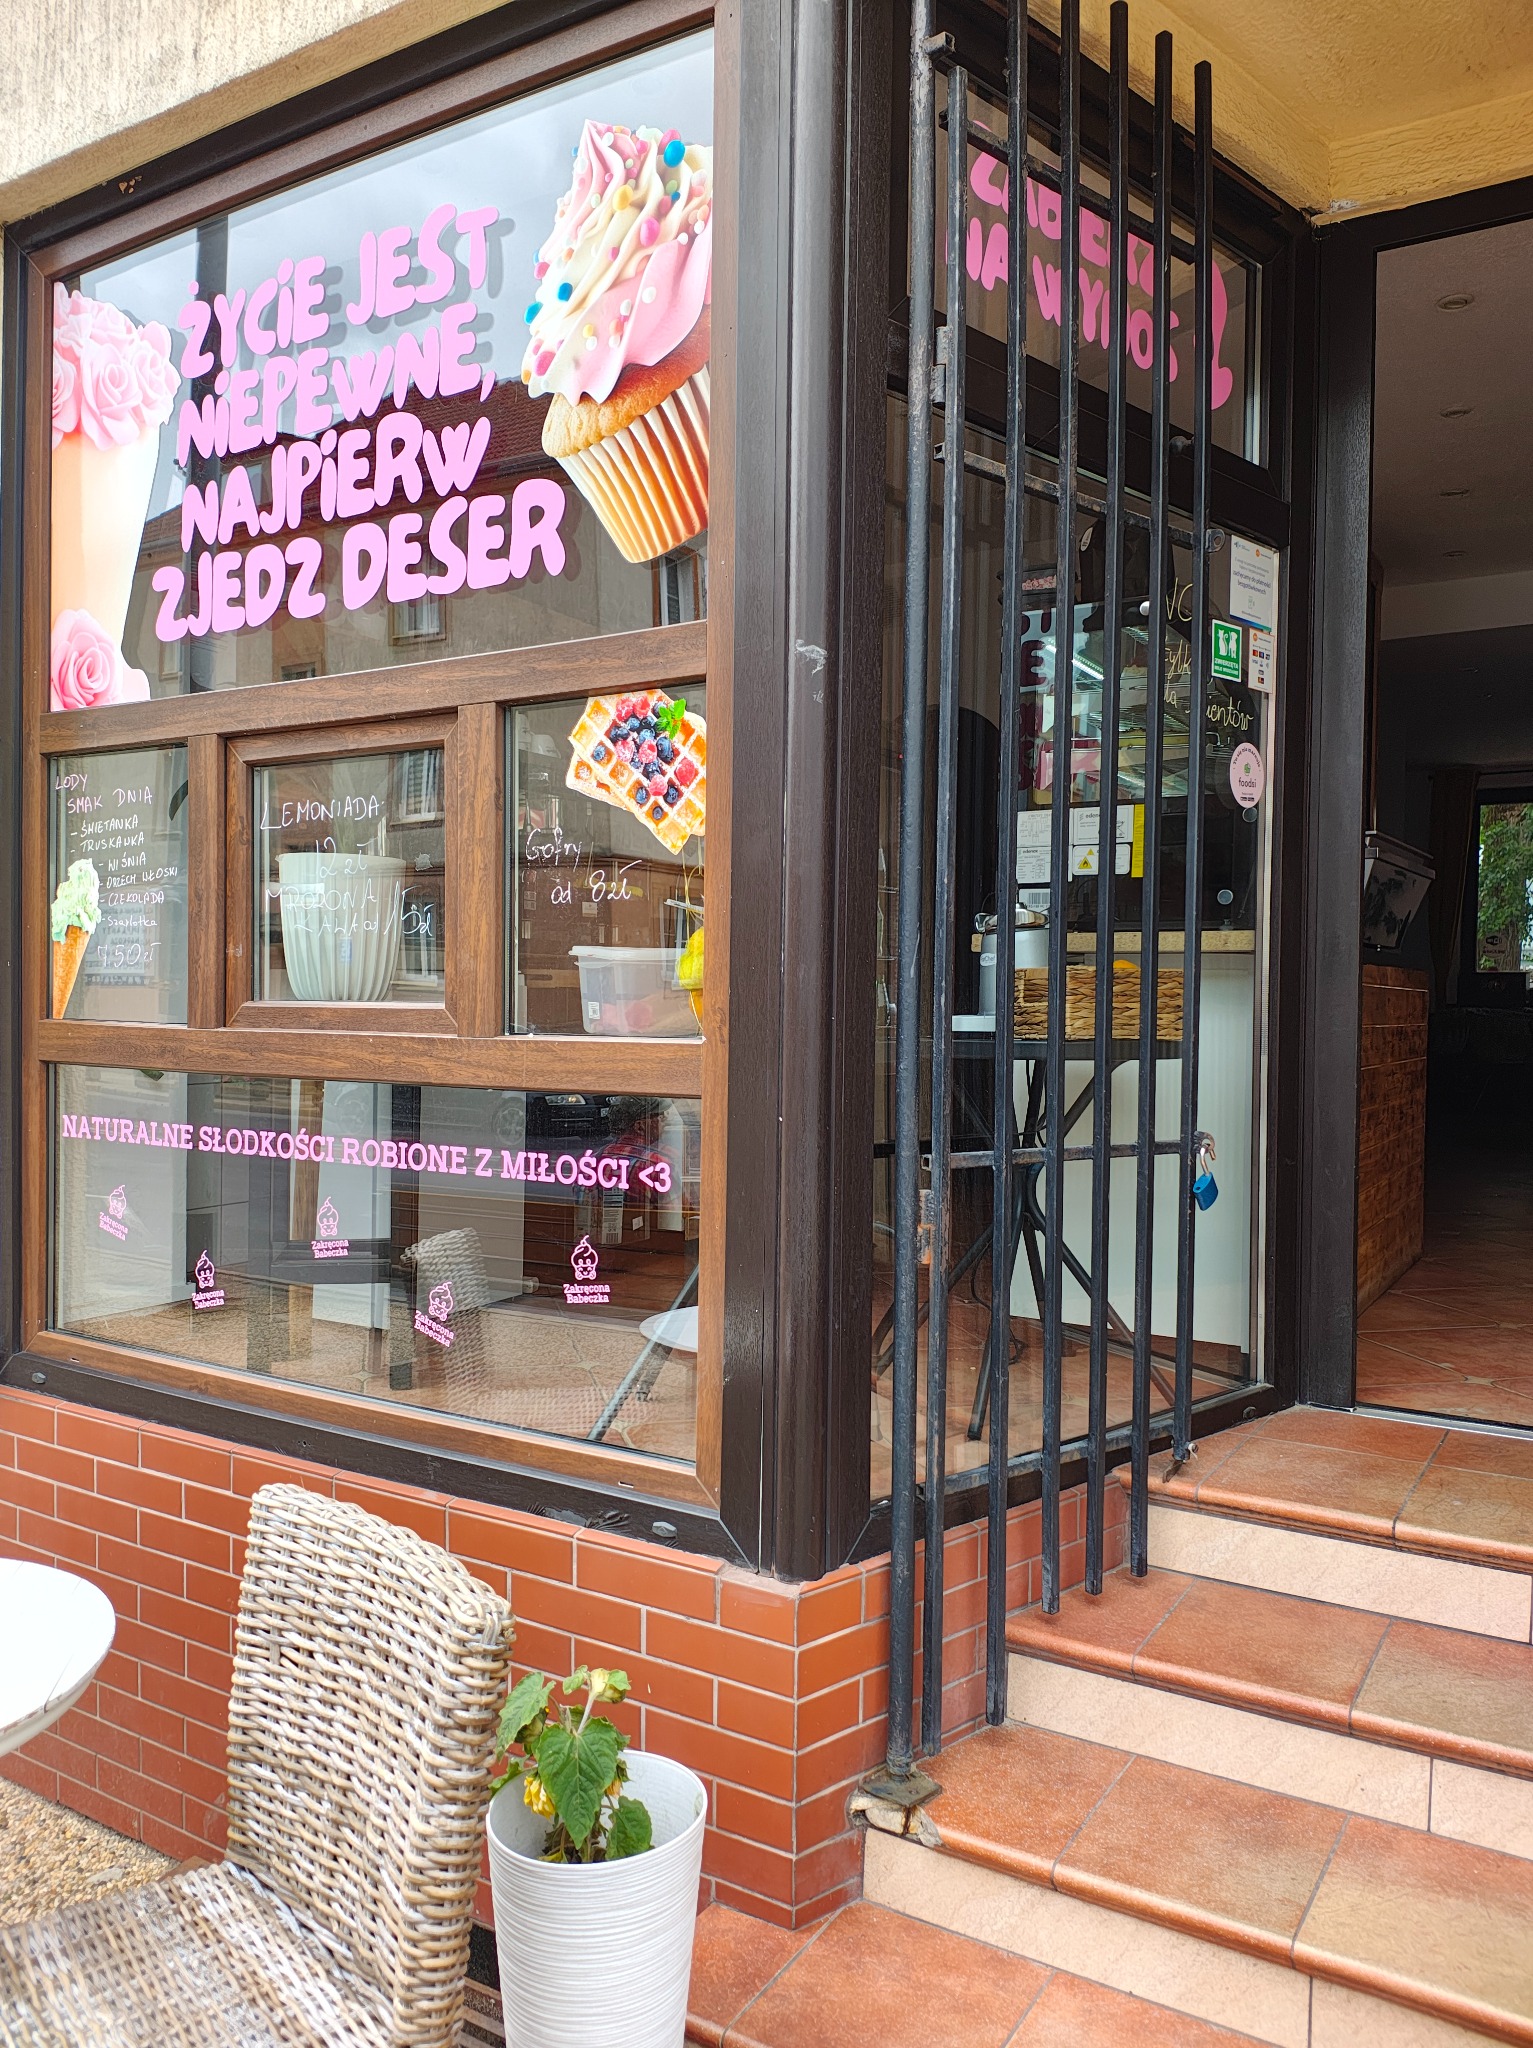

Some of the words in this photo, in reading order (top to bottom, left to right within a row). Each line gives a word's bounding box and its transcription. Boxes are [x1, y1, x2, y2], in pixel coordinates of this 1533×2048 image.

[970, 120, 1154, 298] ZABE
[346, 204, 498, 324] JEST
[152, 535, 326, 641] ZJEDZ
[342, 478, 566, 610] DESER
[1164, 639, 1191, 679] ylk
[55, 774, 88, 792] LODY
[1238, 776, 1257, 788] foodsi
[67, 795, 103, 813] SMAK
[112, 786, 153, 807] DNIA
[62, 1115, 194, 1150] NATURALNE
[199, 1126, 335, 1163] SŁODKOŚCI
[342, 1138, 467, 1174] ROBIONE
[475, 1148, 493, 1177] Z
[501, 1150, 630, 1190] MIŁOŚCI
[639, 1162, 672, 1193] <3
[311, 1239, 349, 1251] Zakręcona
[314, 1248, 348, 1258] Babeczka
[192, 1289, 225, 1302] Zakręcona
[563, 1283, 611, 1295] Zakręcona
[566, 1293, 610, 1304] Babeczka
[194, 1297, 224, 1309] Babeczka
[414, 1319, 450, 1347] Babeczka
[415, 1310, 454, 1340] Zakręcona
